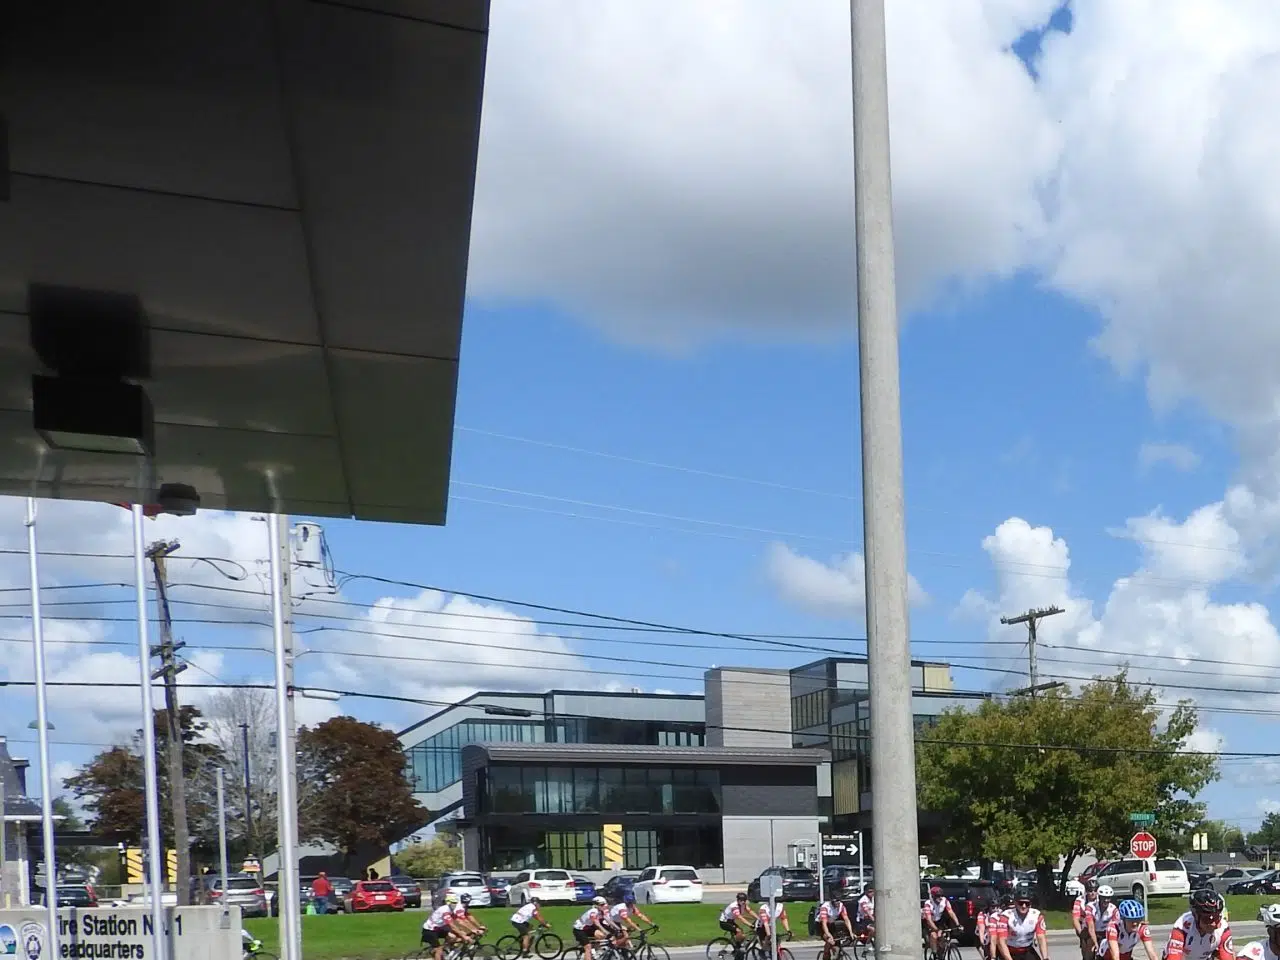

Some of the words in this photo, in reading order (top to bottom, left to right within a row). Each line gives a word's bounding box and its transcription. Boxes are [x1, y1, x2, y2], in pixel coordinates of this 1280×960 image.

[1133, 841, 1154, 851] STOP
[57, 915, 77, 935] ire
[83, 915, 137, 935] Station
[175, 915, 182, 935] 1
